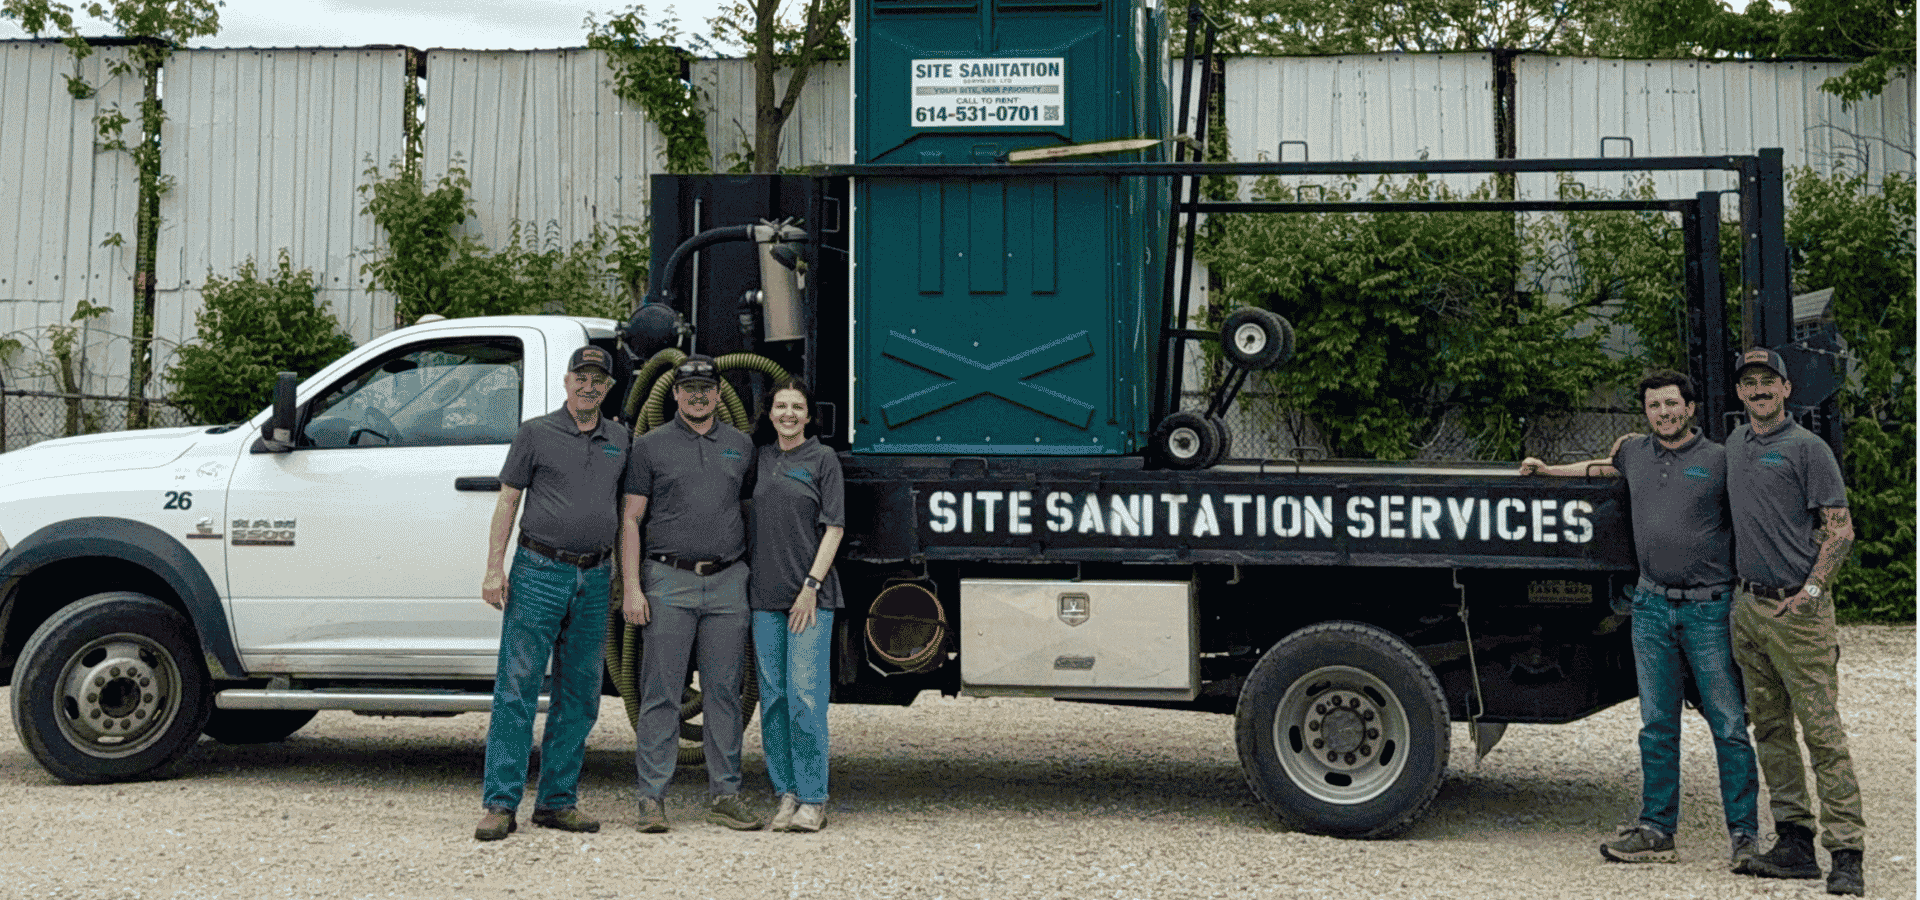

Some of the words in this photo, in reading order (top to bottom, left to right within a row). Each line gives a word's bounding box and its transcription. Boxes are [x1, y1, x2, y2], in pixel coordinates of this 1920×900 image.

[915, 64, 952, 78] SITE
[959, 62, 1059, 78] SANITATION
[934, 86, 957, 94] YOUR
[1002, 86, 1042, 94] PRIORITY
[956, 97, 978, 105] CALL
[982, 97, 993, 105] TO
[915, 105, 1039, 122] 614-531-0701
[163, 491, 193, 511] 26
[232, 518, 296, 529] RAM
[929, 491, 1033, 534] SITE
[1046, 492, 1334, 538] SANITATION
[1346, 495, 1594, 543] SERVICES
[232, 529, 296, 541] 5500
